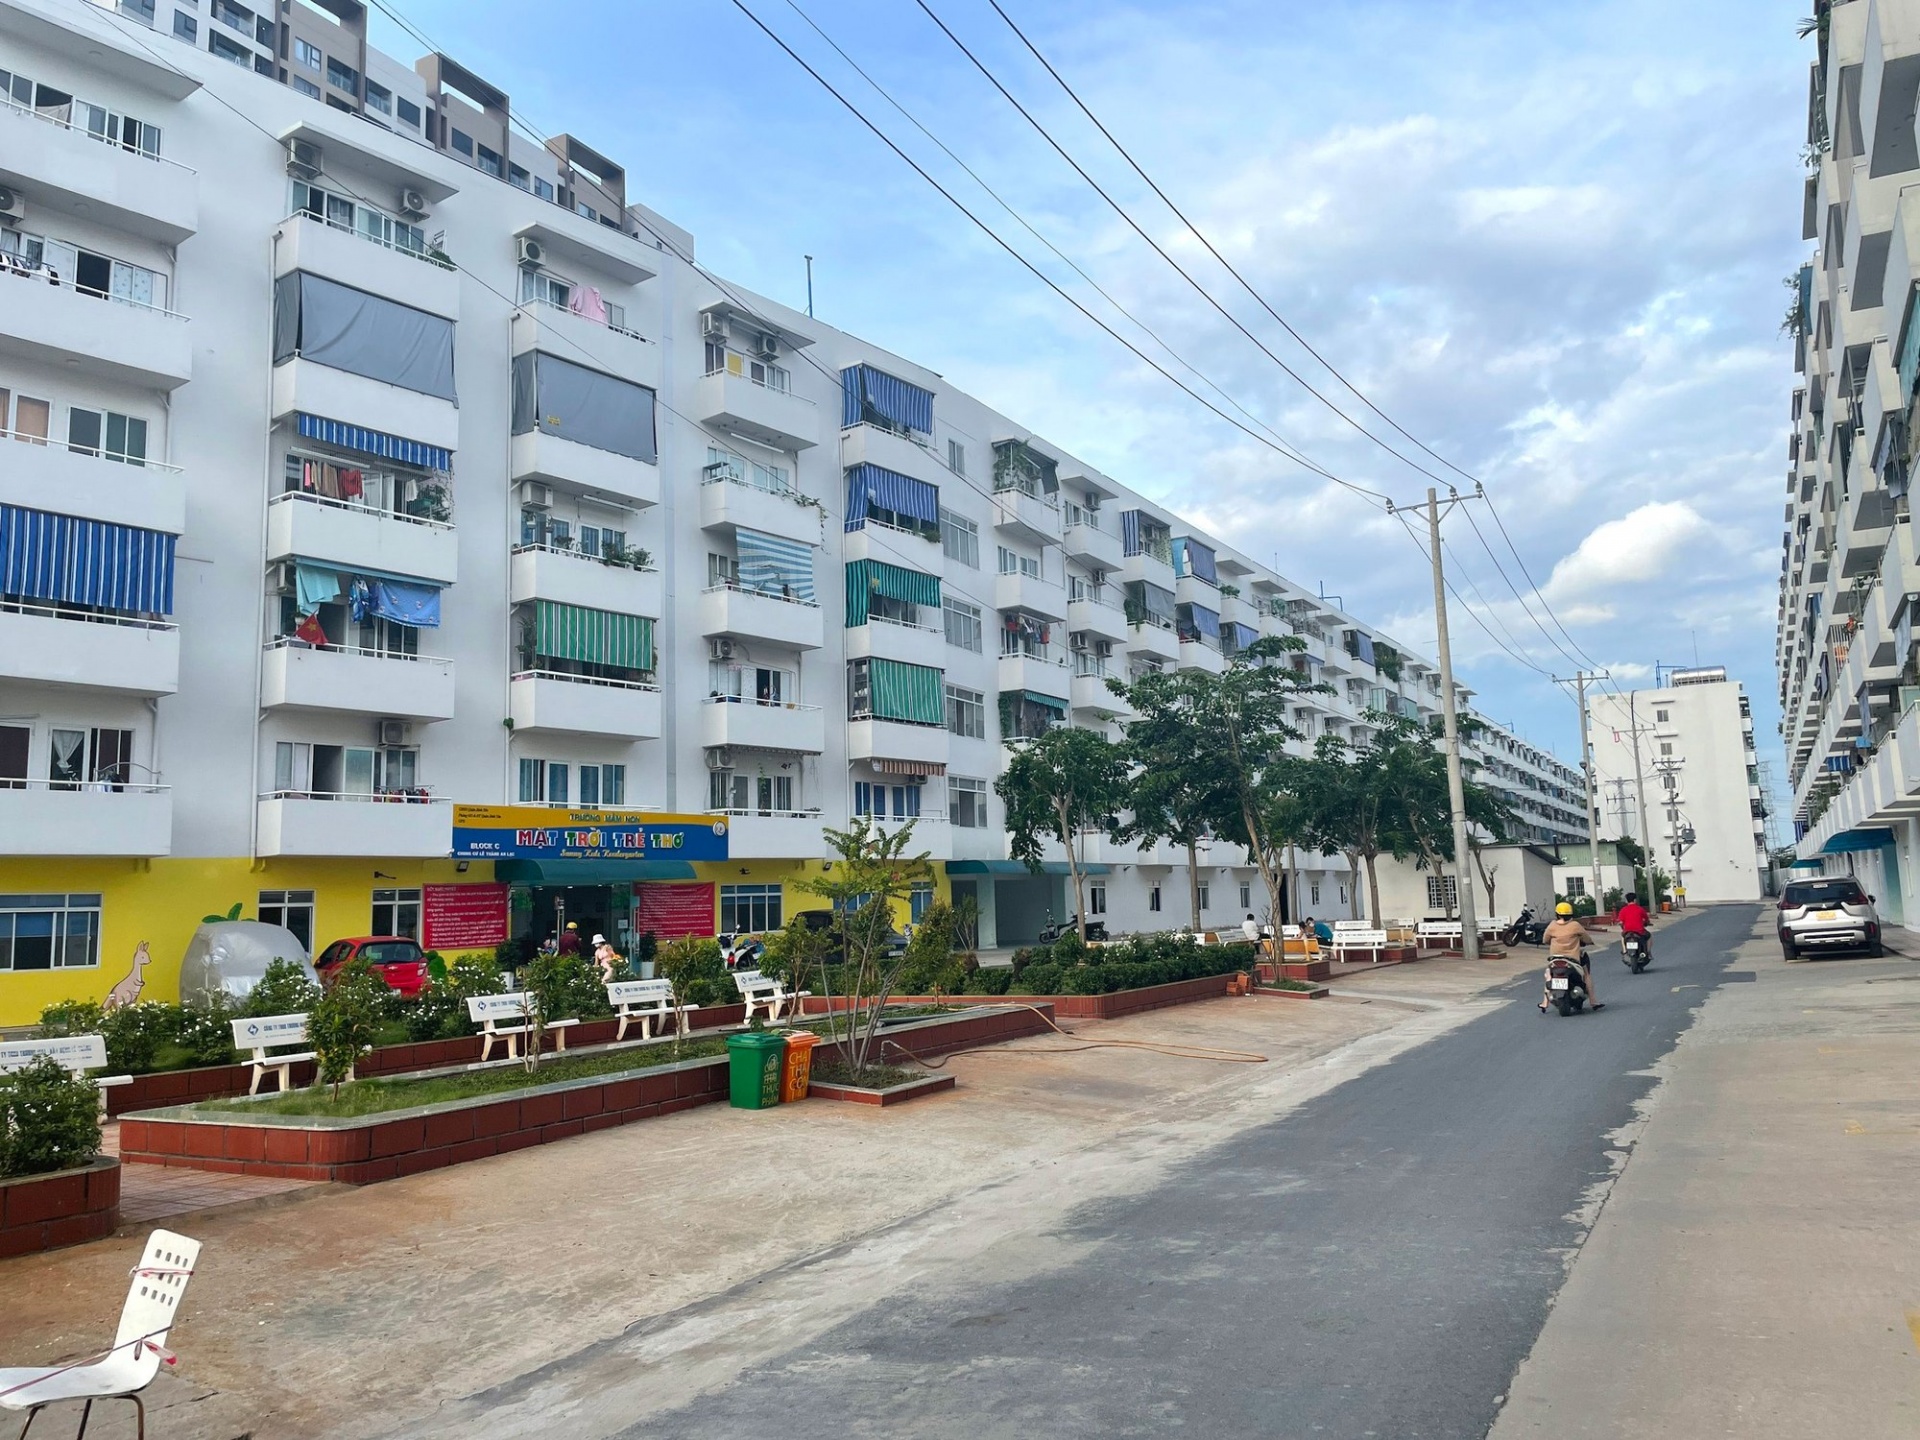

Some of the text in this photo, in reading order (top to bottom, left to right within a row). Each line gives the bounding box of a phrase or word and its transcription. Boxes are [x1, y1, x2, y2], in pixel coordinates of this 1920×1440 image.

[624, 815, 640, 823] NON
[516, 827, 685, 849] MẶT TRỜI TRẺ THƠ
[470, 842, 493, 850] BLOCK
